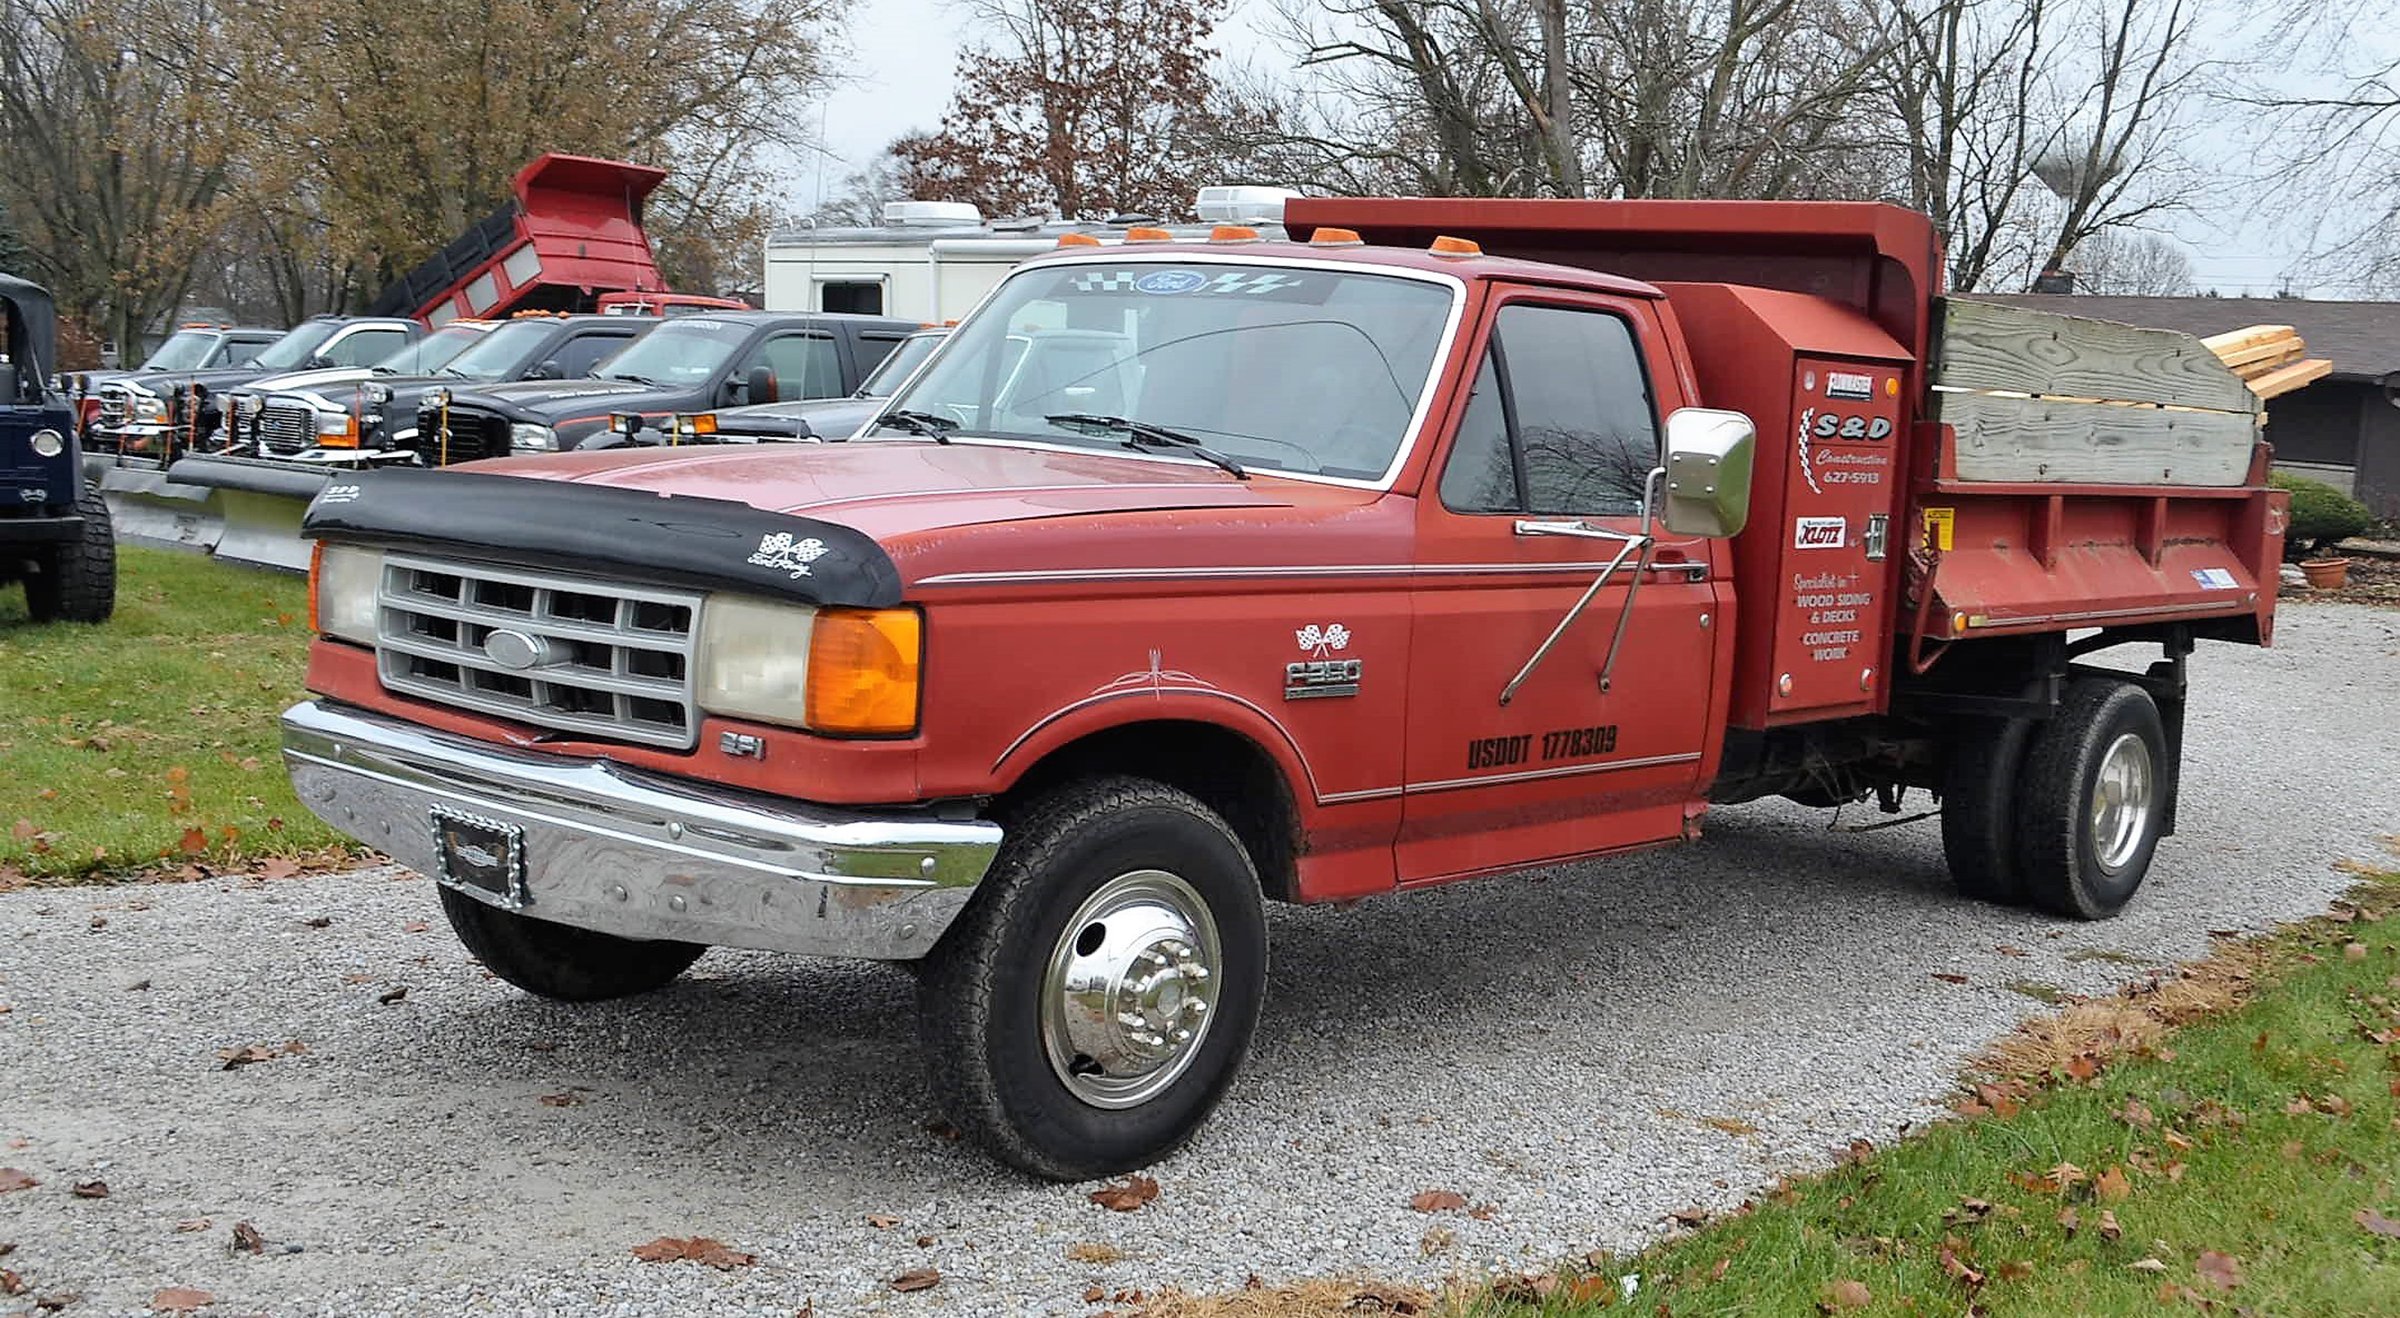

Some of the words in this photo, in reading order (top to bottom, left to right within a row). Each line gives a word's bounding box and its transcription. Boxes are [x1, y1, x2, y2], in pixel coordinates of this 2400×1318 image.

[1797, 594, 1834, 608] WOOD
[1837, 592, 1871, 606] SIDING
[1822, 609, 1857, 623] DECKS
[1802, 629, 1861, 646] CONCRETE
[1813, 646, 1847, 661] WORK
[1467, 733, 1533, 770] USDOT
